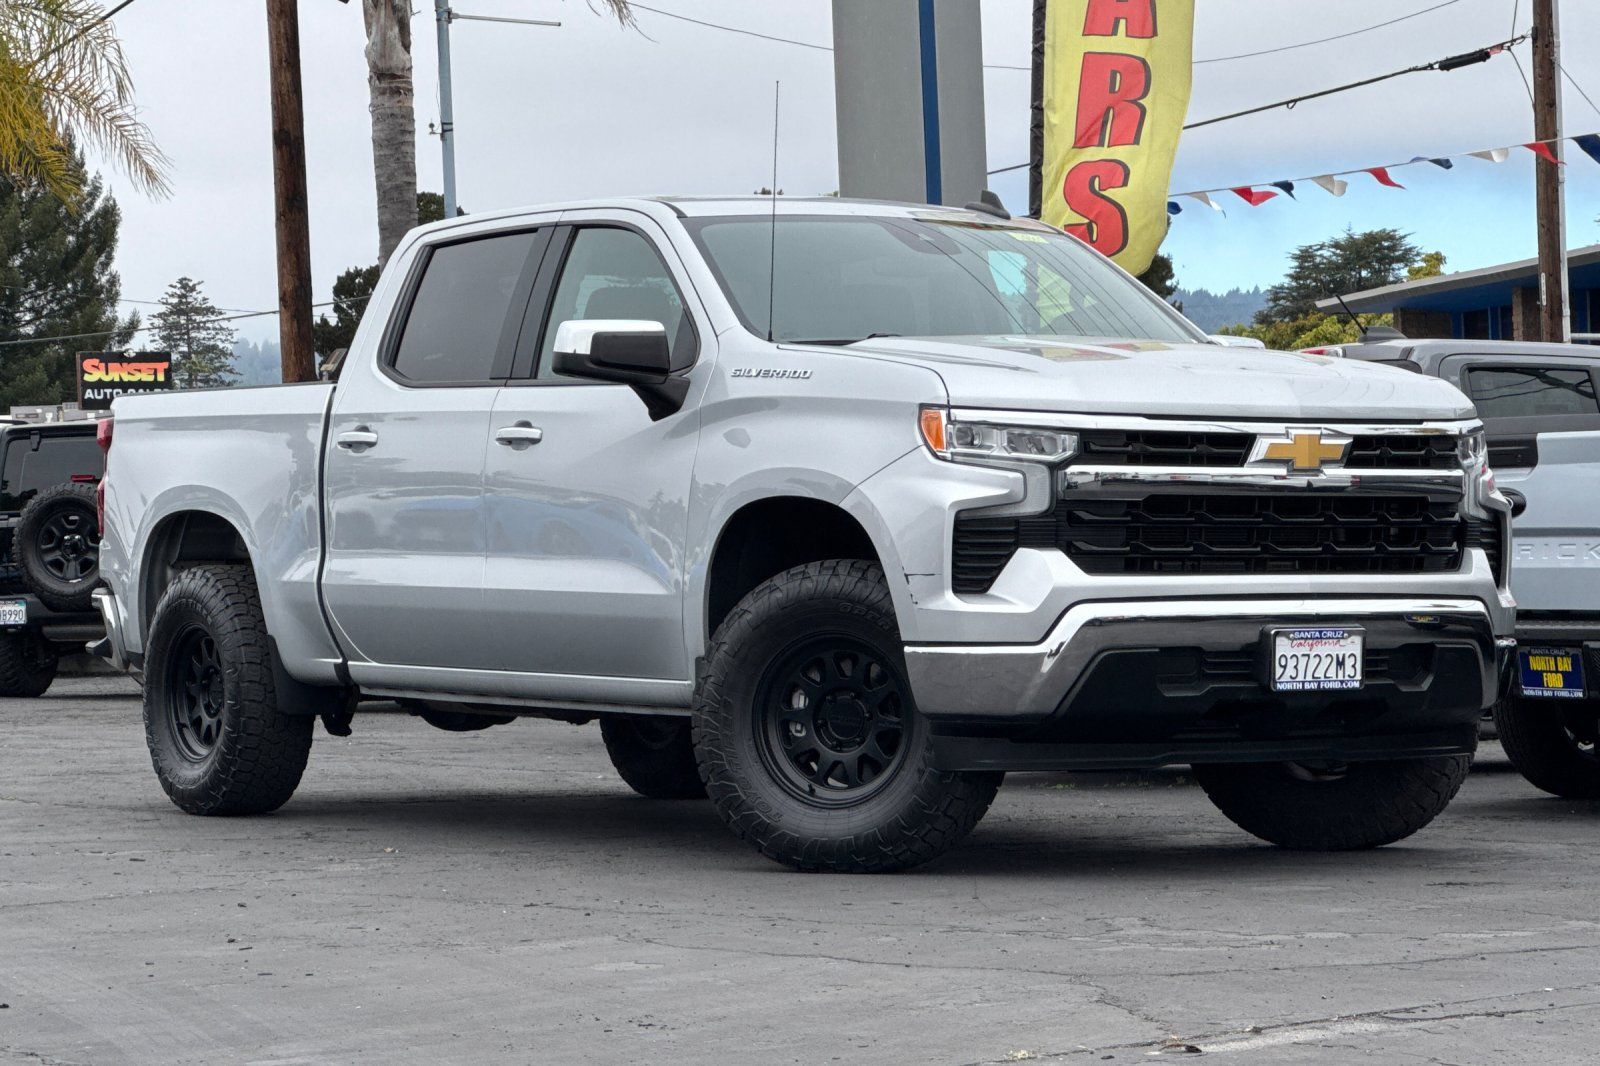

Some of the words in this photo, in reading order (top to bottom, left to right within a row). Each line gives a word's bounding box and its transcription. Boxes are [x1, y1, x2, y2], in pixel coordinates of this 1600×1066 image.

[82, 358, 170, 382] SUNSET
[731, 368, 814, 379] SILVERADO
[84, 388, 123, 400] AUTO
[1290, 639, 1346, 651] California
[1276, 653, 1357, 680] 93722M3
[1529, 656, 1556, 670] NORTH
[1557, 656, 1572, 672] BAY
[1320, 680, 1360, 688] FORD.COM
[1543, 672, 1564, 688] FORD
